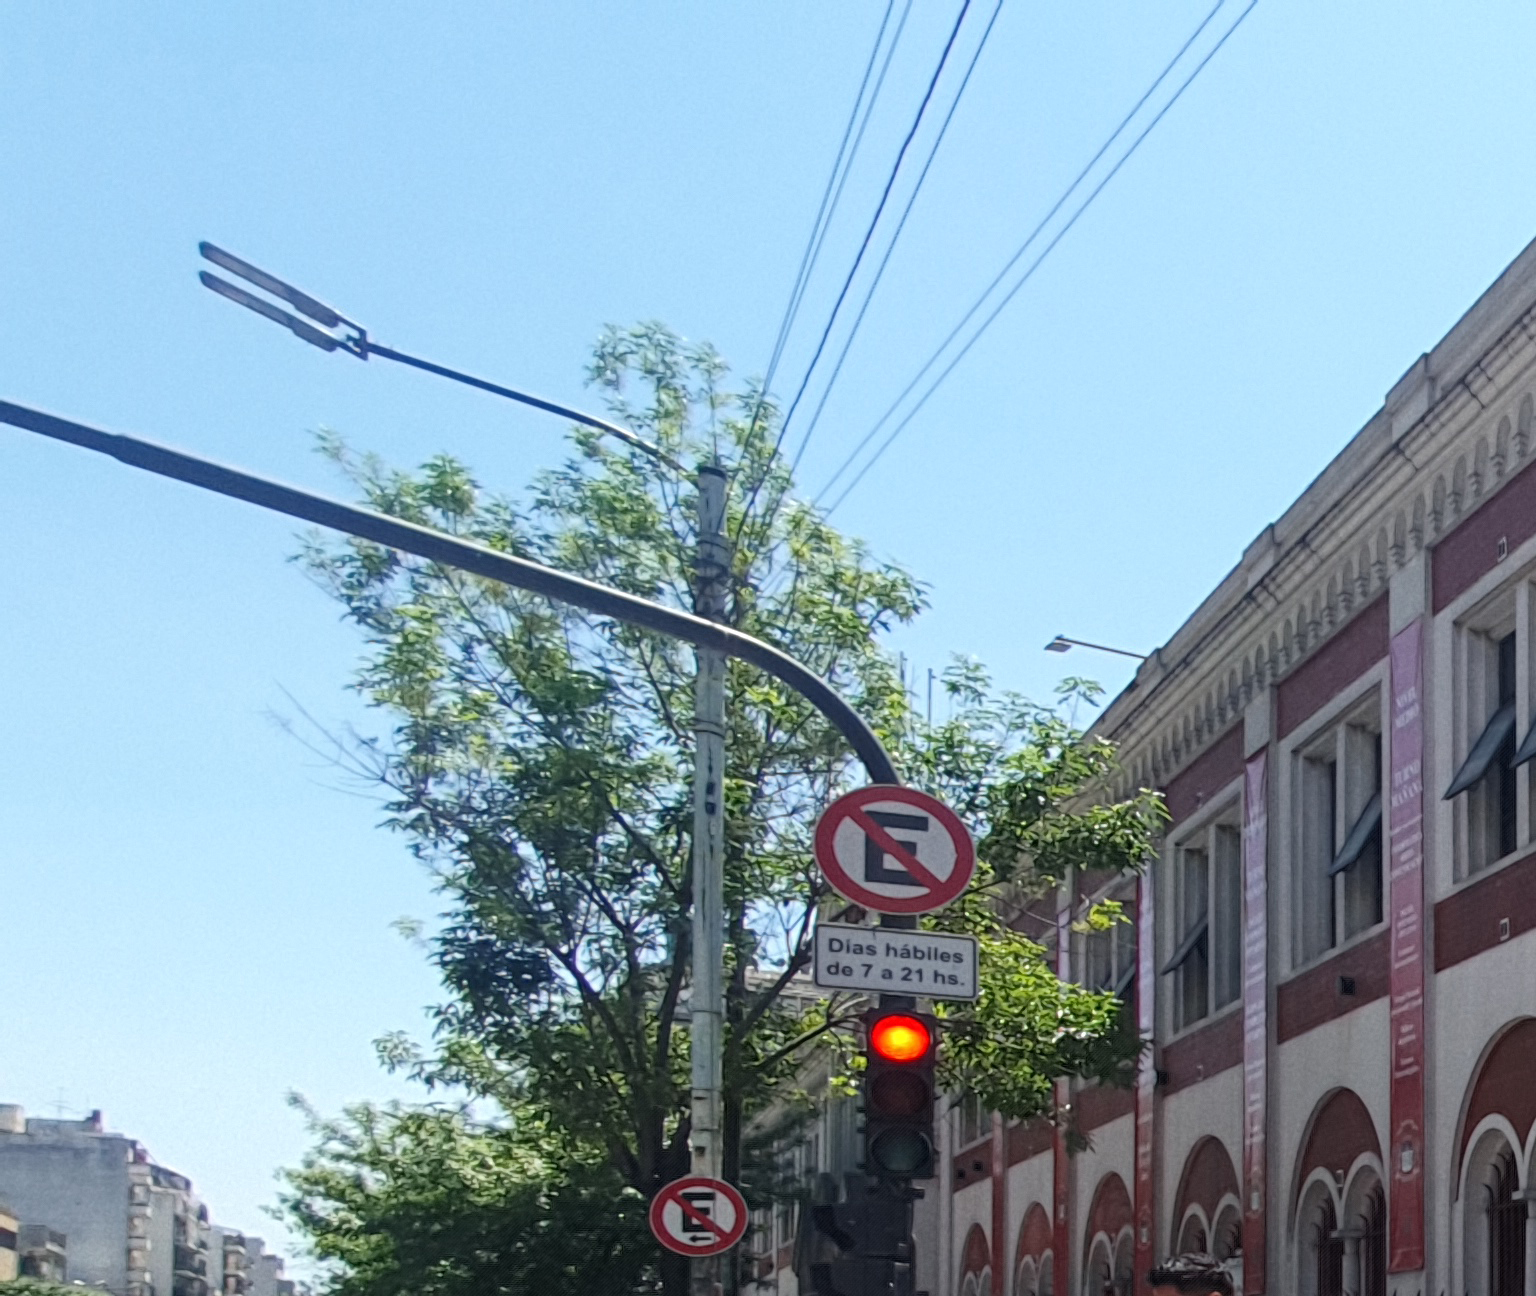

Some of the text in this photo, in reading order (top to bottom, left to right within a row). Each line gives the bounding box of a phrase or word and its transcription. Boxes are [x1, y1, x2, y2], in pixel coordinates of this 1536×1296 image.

[885, 942, 964, 964] hábiles
[826, 961, 965, 986] de 7 a 21 hs.
